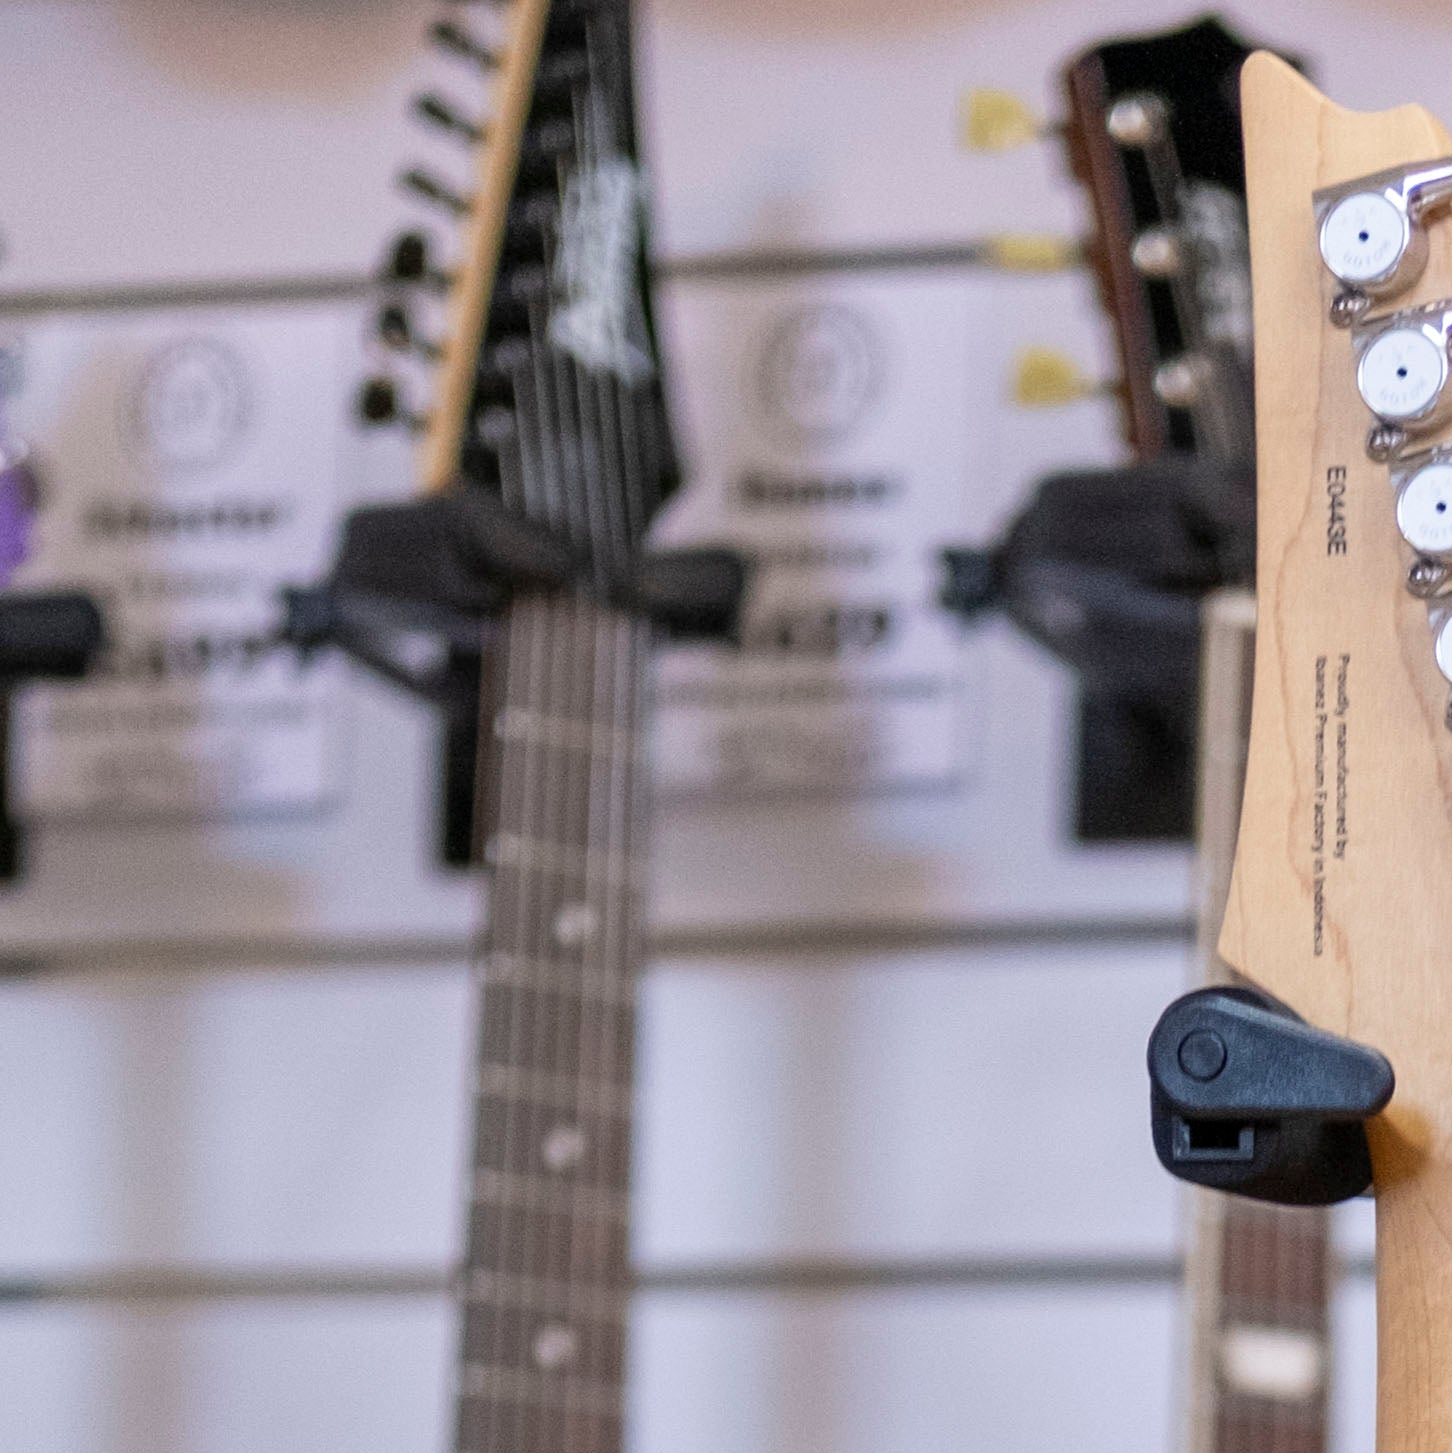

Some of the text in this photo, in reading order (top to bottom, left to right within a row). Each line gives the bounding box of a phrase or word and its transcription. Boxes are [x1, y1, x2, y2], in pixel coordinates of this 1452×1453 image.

[1311, 655, 1327, 956] Ibanez Premium Factory in Indonesia
[1333, 654, 1350, 860] Proudly manufactured by
